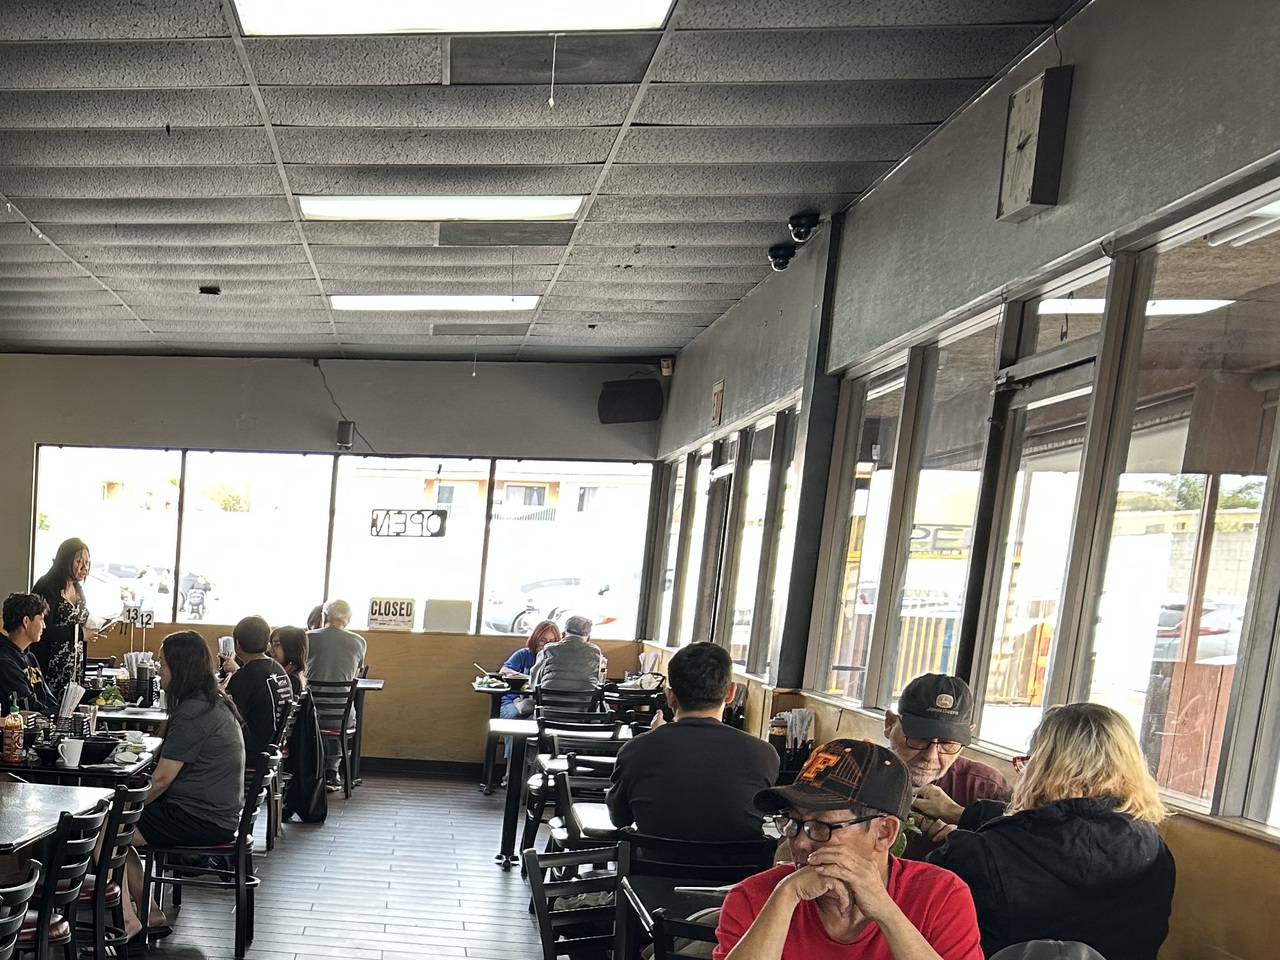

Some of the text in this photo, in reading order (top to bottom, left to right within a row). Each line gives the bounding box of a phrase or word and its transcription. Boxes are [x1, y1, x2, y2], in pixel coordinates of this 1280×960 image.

[126, 608, 139, 621] 13
[370, 600, 413, 617] CLOSED
[140, 613, 152, 625] 12
